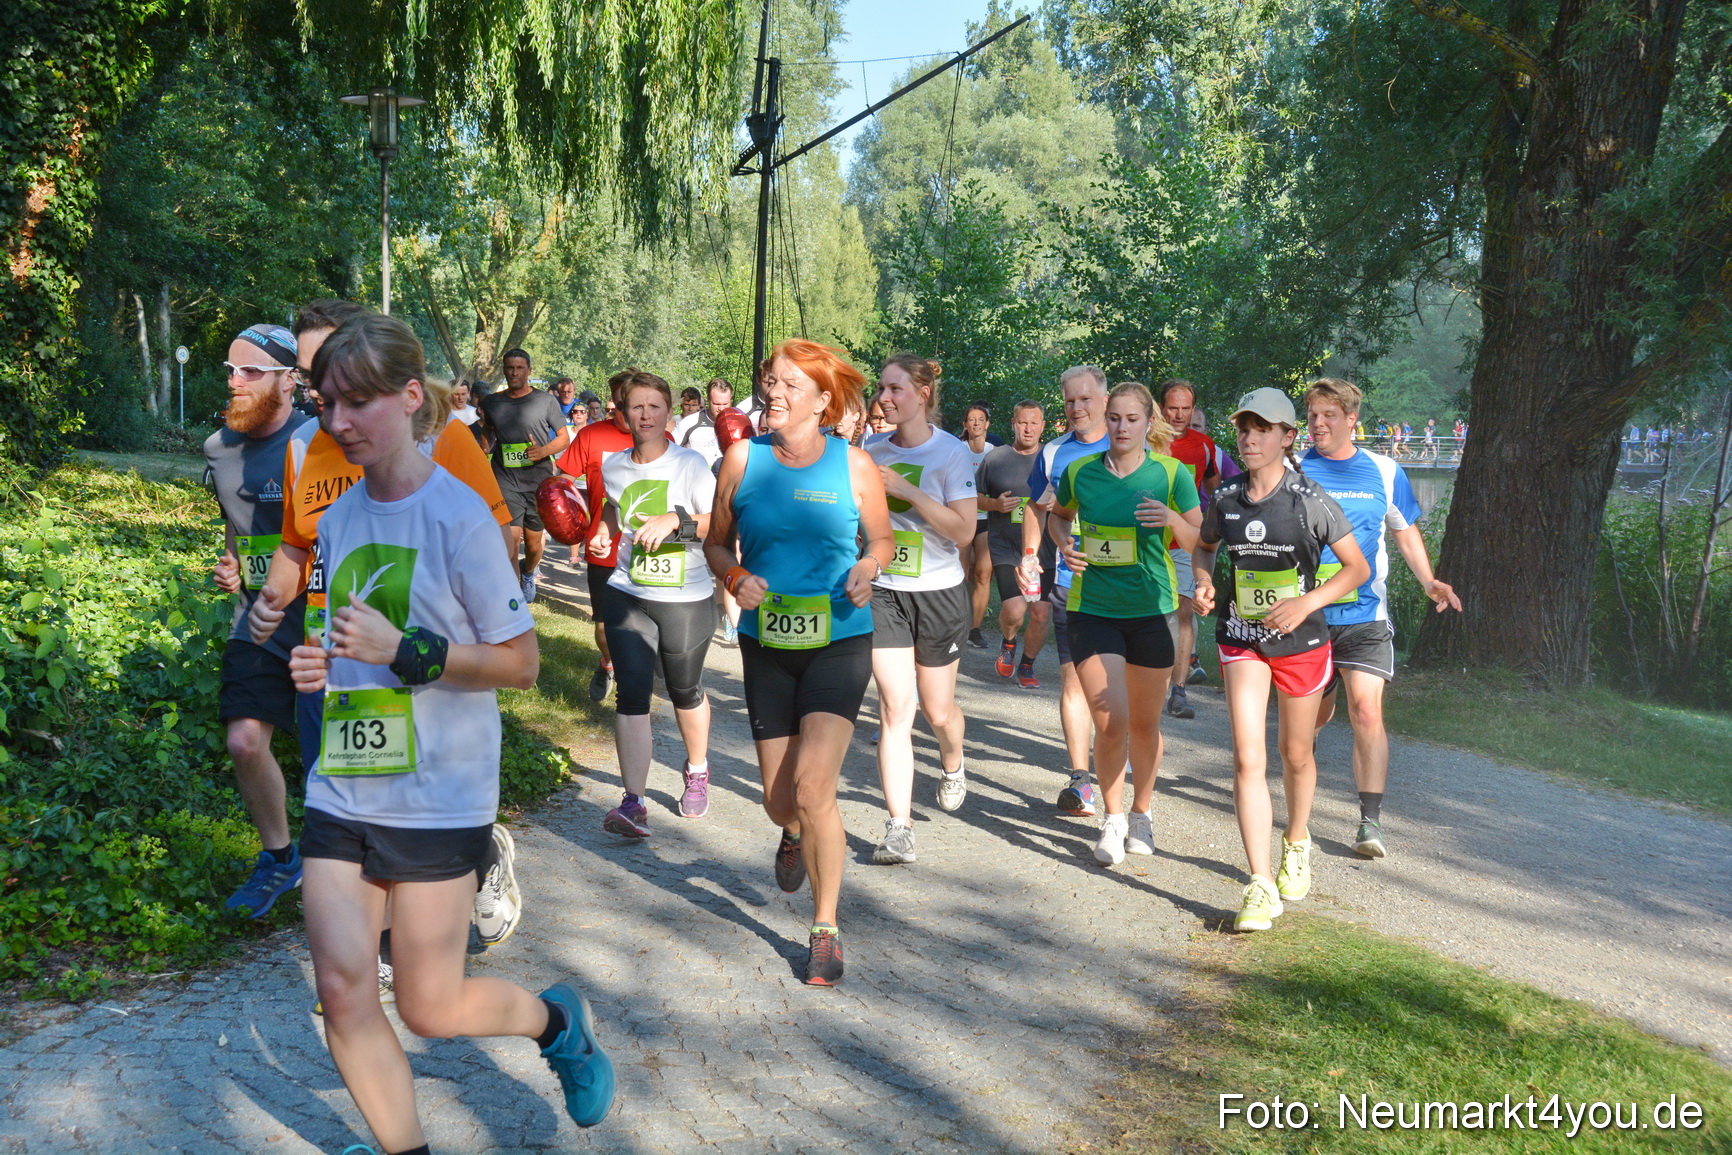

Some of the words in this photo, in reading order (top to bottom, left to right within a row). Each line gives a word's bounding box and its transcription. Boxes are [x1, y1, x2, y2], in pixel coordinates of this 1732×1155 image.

[505, 451, 529, 461] 1366
[304, 483, 316, 505] BIT
[1133, 488, 1155, 497] AOK
[1326, 490, 1375, 500] iegeladen
[809, 496, 838, 504] Blendinger
[1100, 540, 1112, 555] 4
[641, 556, 671, 573] 133
[1253, 589, 1278, 606] 86
[766, 612, 818, 634] 2031
[774, 633, 795, 641] Stiegler
[340, 720, 387, 750] 163
[368, 750, 404, 760] Cornelia
